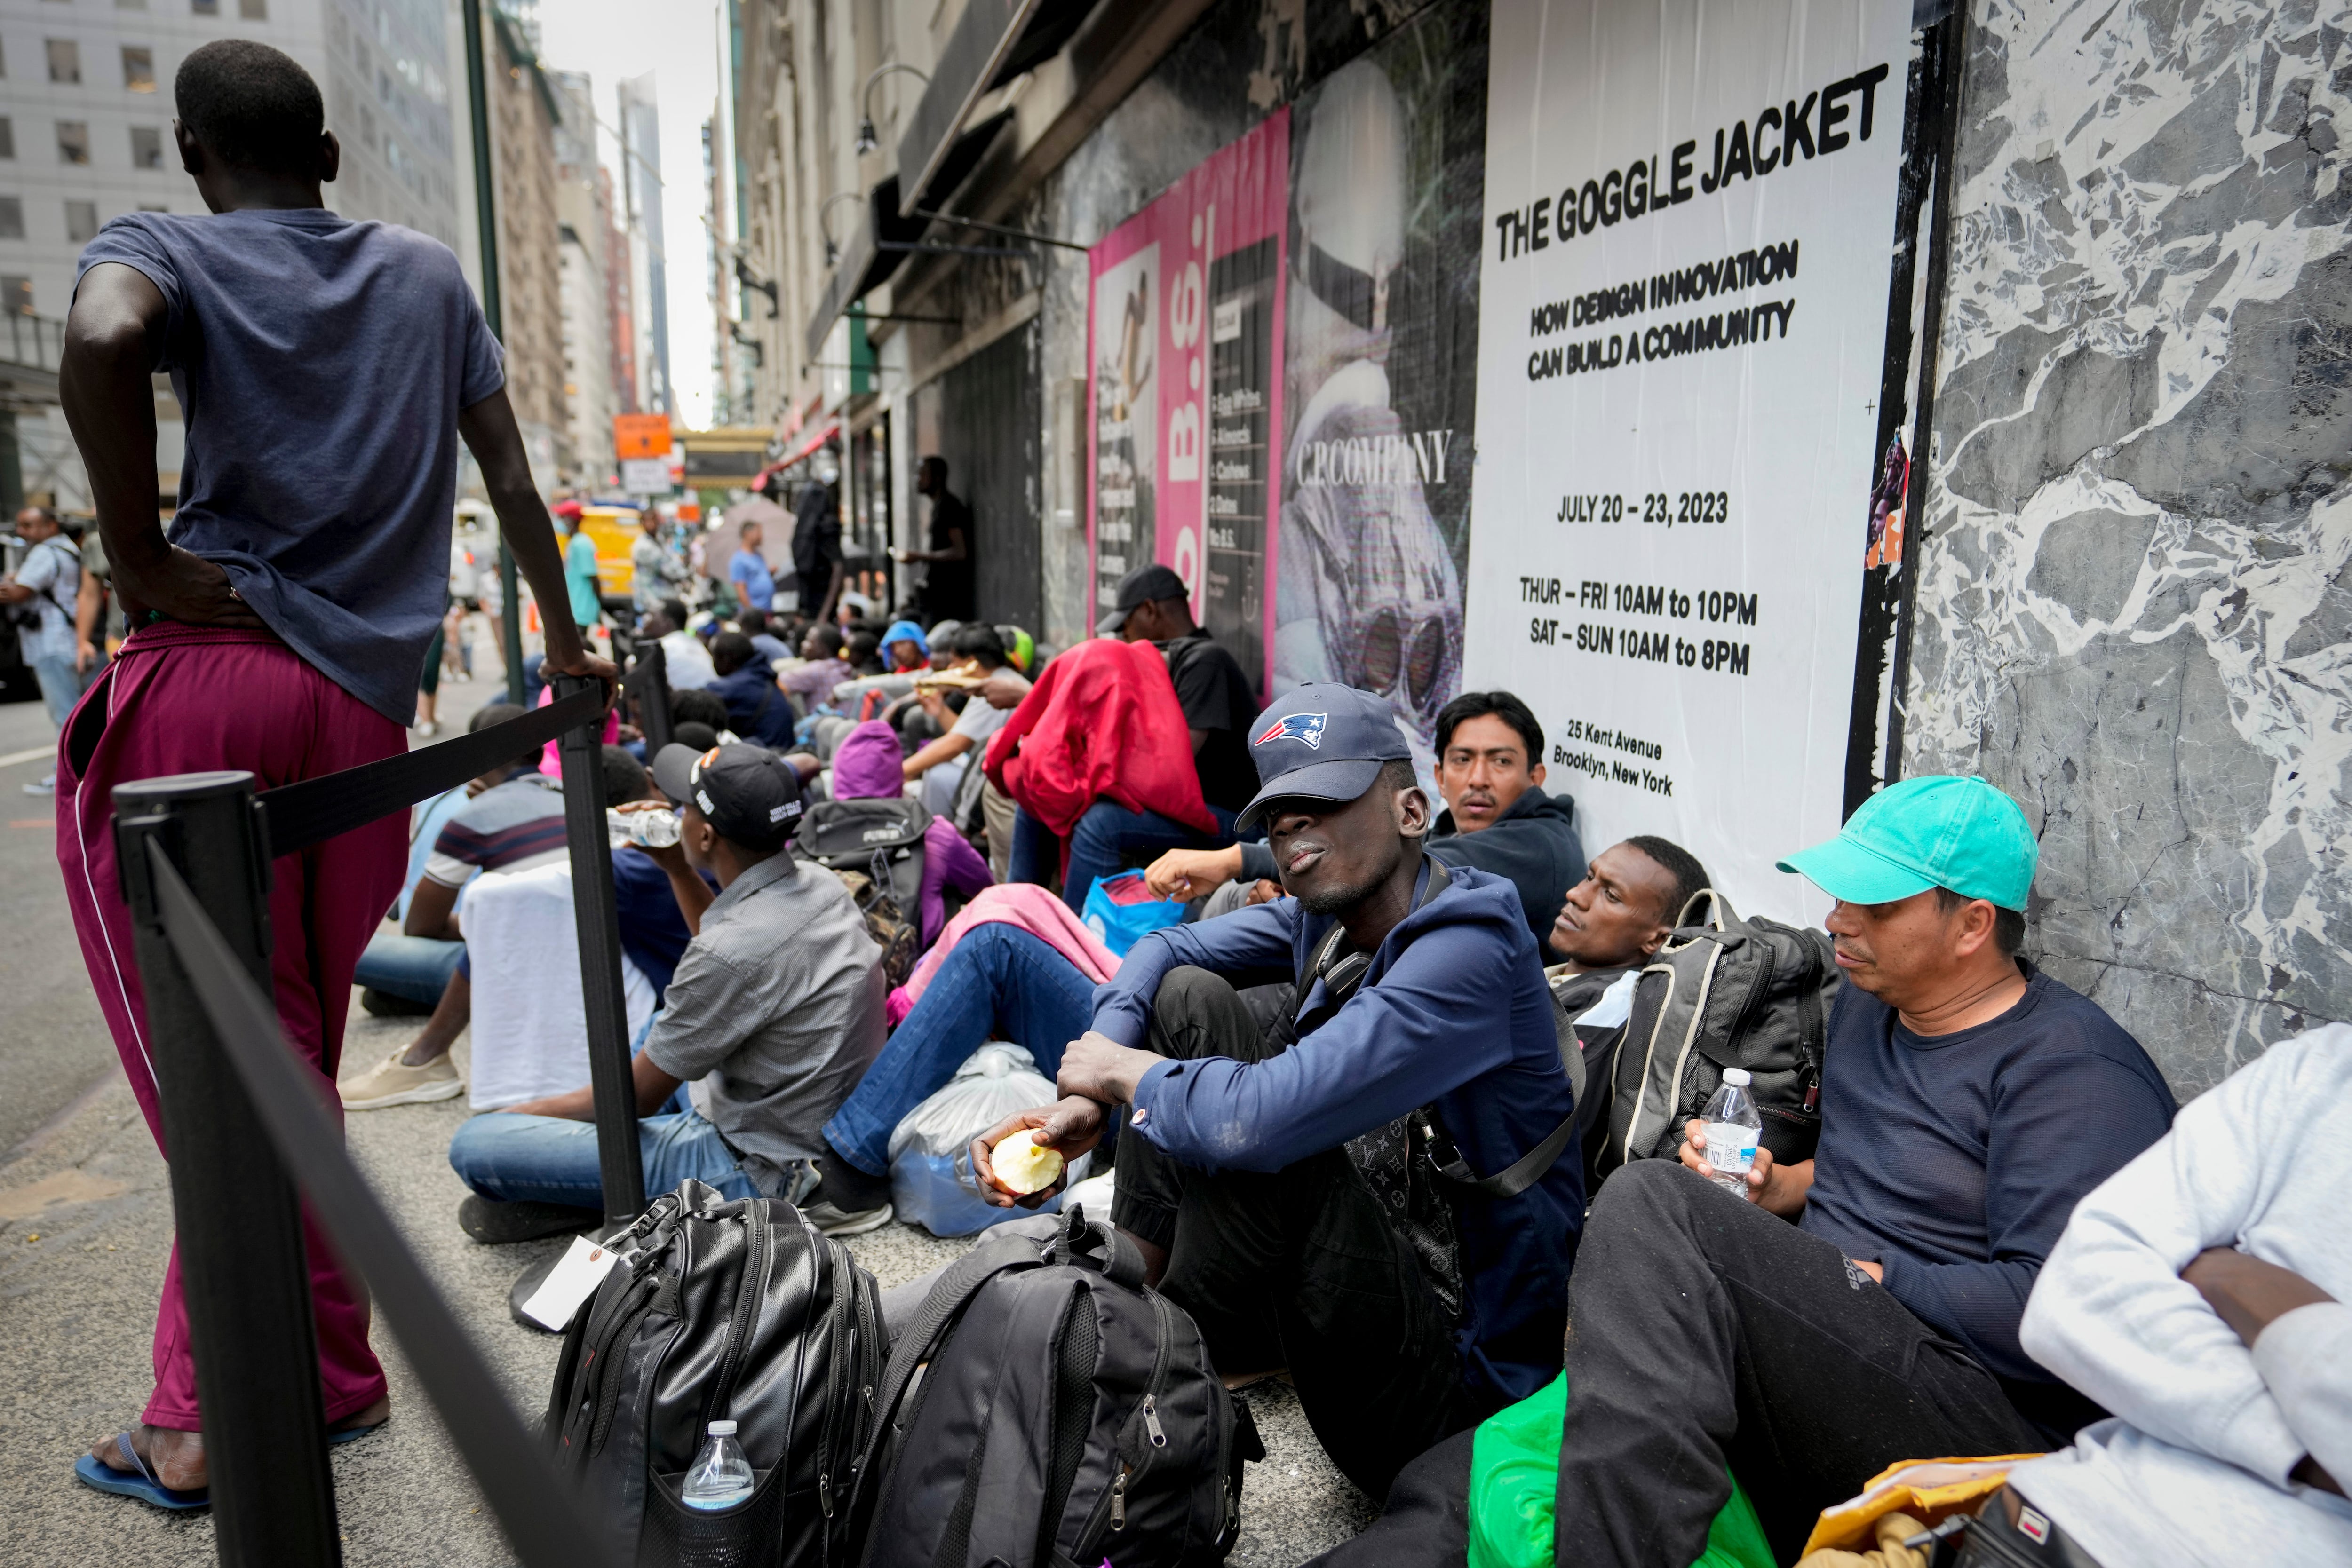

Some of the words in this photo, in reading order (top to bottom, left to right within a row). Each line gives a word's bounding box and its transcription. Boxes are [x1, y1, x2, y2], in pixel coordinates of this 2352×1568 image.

[1496, 197, 1551, 262] THE
[1557, 139, 1696, 242] GOGGLE
[1700, 63, 1889, 194] JACKET
[1531, 300, 1569, 337] HOW
[1573, 279, 1646, 328] DESIGN
[1650, 239, 1799, 310] INNOVATION
[1528, 348, 1562, 381] CAN
[1567, 335, 1622, 375] BUILD
[1626, 332, 1640, 364] A
[1643, 298, 1795, 361] COMMUNITY
[1558, 496, 1597, 522] JULY
[1601, 495, 1622, 523] 20
[1678, 491, 1728, 523] 2023
[1520, 577, 1560, 604] THUR
[1581, 581, 1607, 610] FRI
[1615, 585, 1664, 615] 10AM
[1669, 589, 1690, 618] to
[1698, 591, 1757, 626] 10PM
[1531, 618, 1558, 645] SAT
[1577, 624, 1613, 654] SUN
[1620, 630, 1669, 663] 10AM
[1675, 637, 1696, 667] to
[1702, 640, 1750, 676] 8PM
[1567, 720, 1582, 739] 25
[1585, 723, 1613, 747] Kent
[1614, 731, 1661, 760] Avenue
[1554, 745, 1608, 781] Brooklyn,
[1612, 761, 1639, 786] New
[1643, 769, 1672, 797] York
